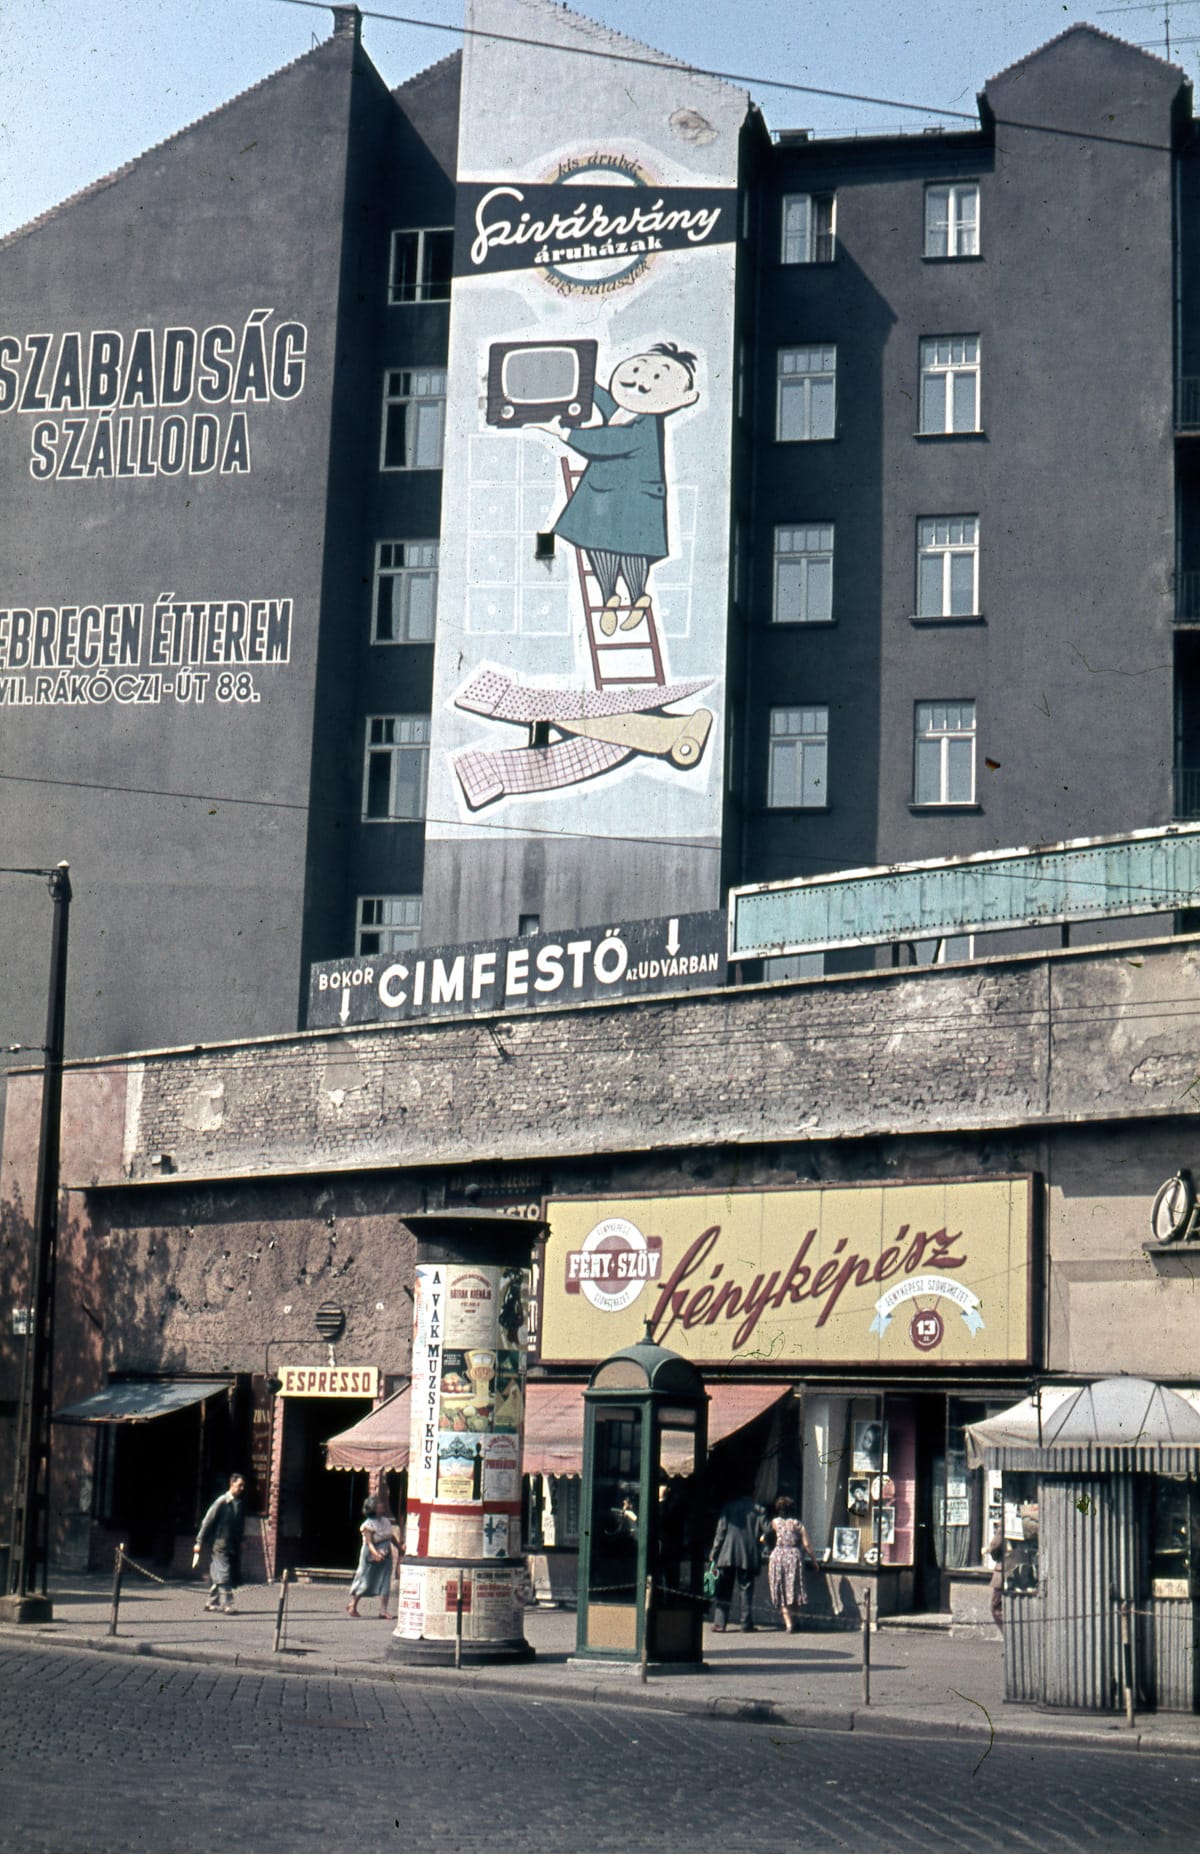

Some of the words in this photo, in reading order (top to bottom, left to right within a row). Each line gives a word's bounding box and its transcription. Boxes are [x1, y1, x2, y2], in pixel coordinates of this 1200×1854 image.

[558, 158, 580, 177] kis
[471, 187, 722, 264] Szivárvány
[534, 236, 664, 264] áruházak
[0, 308, 307, 414] SZABADSÁG
[30, 408, 250, 480] SZÁLLODA
[150, 592, 293, 667] ÉTTEREM
[216, 673, 261, 702] 88.
[318, 966, 375, 991] BOKOR
[378, 928, 628, 1008] CIMFESTŐ
[625, 967, 638, 981] AZ
[638, 952, 719, 979] UDVARBAN
[917, 1319, 936, 1335] 13
[286, 1371, 371, 1393] ESPRESSO
